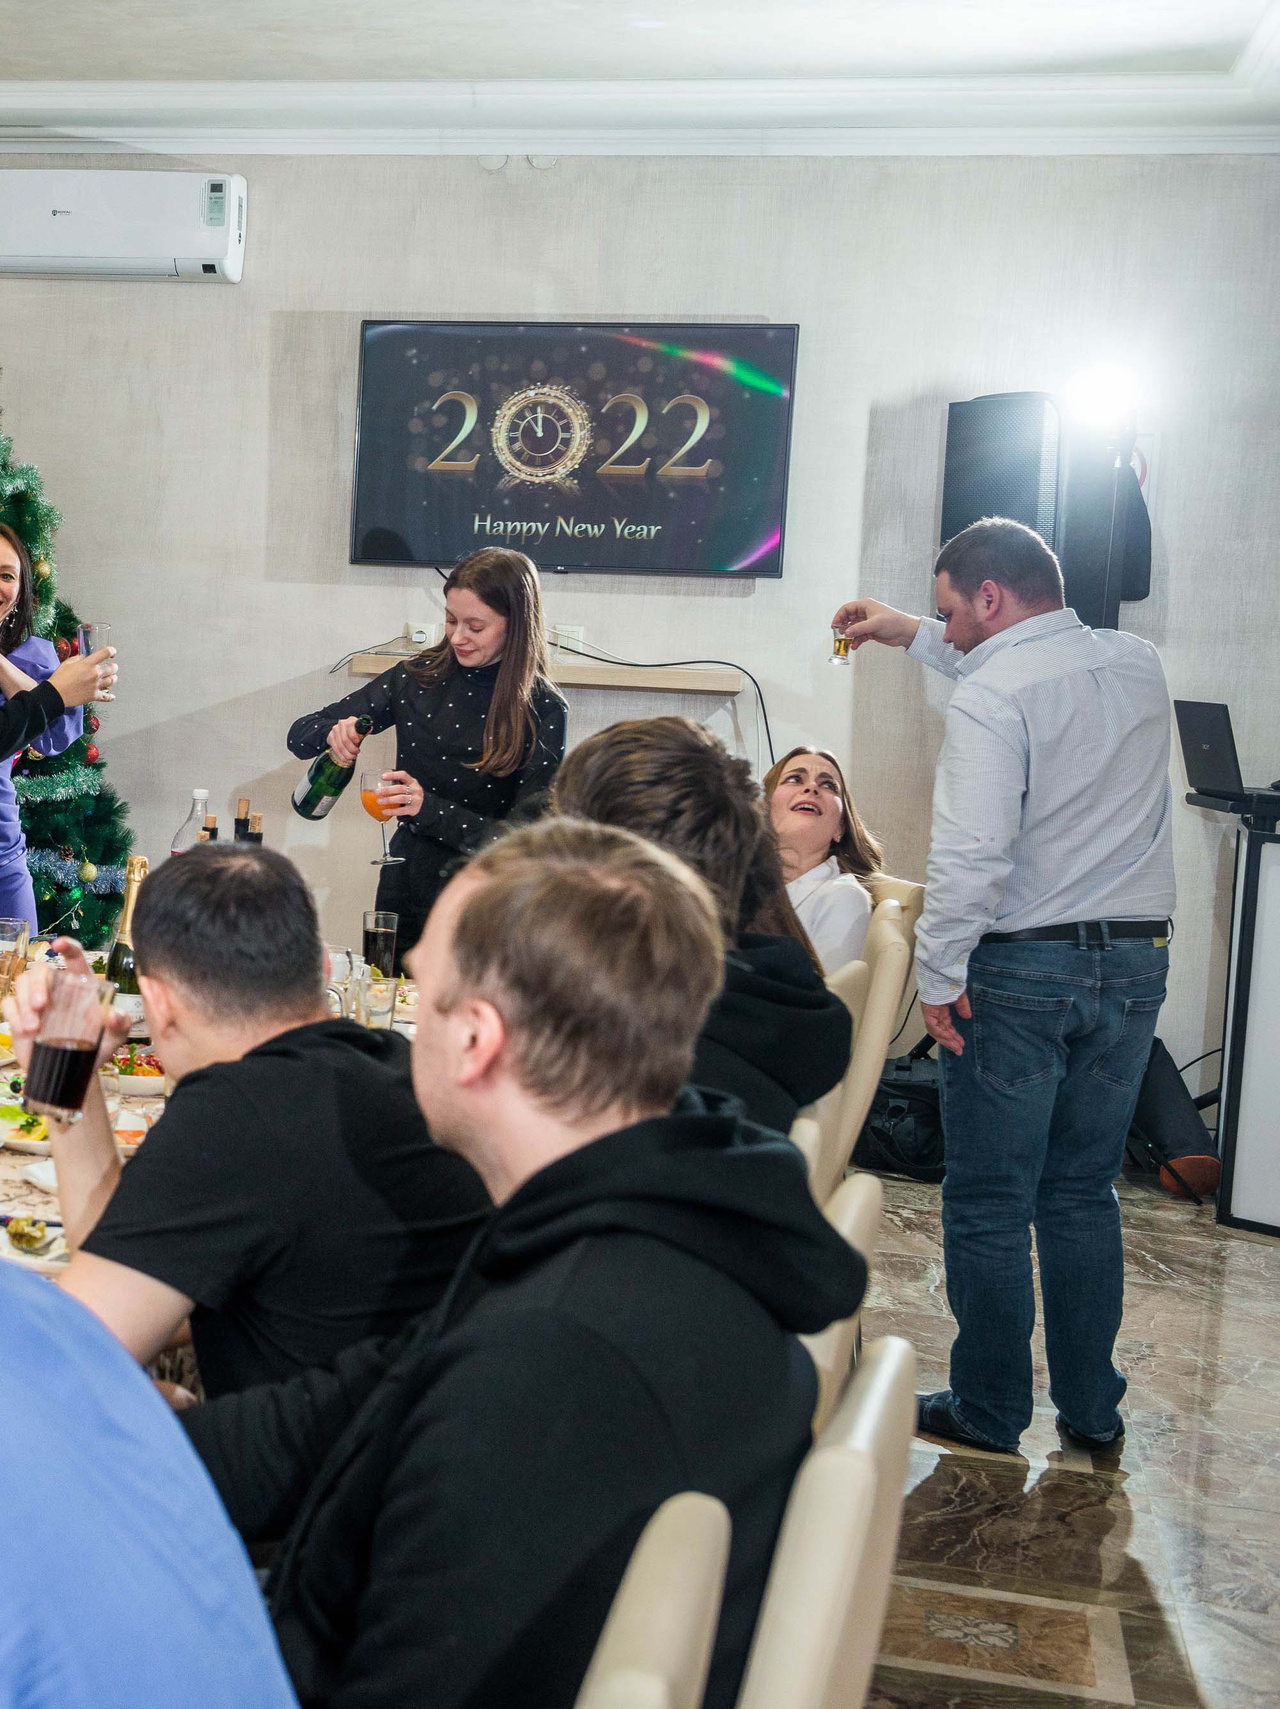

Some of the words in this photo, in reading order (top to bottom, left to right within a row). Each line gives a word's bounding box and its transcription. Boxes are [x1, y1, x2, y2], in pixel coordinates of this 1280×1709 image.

[473, 512, 549, 544] Happy
[554, 515, 606, 541] New
[611, 516, 662, 540] Year
